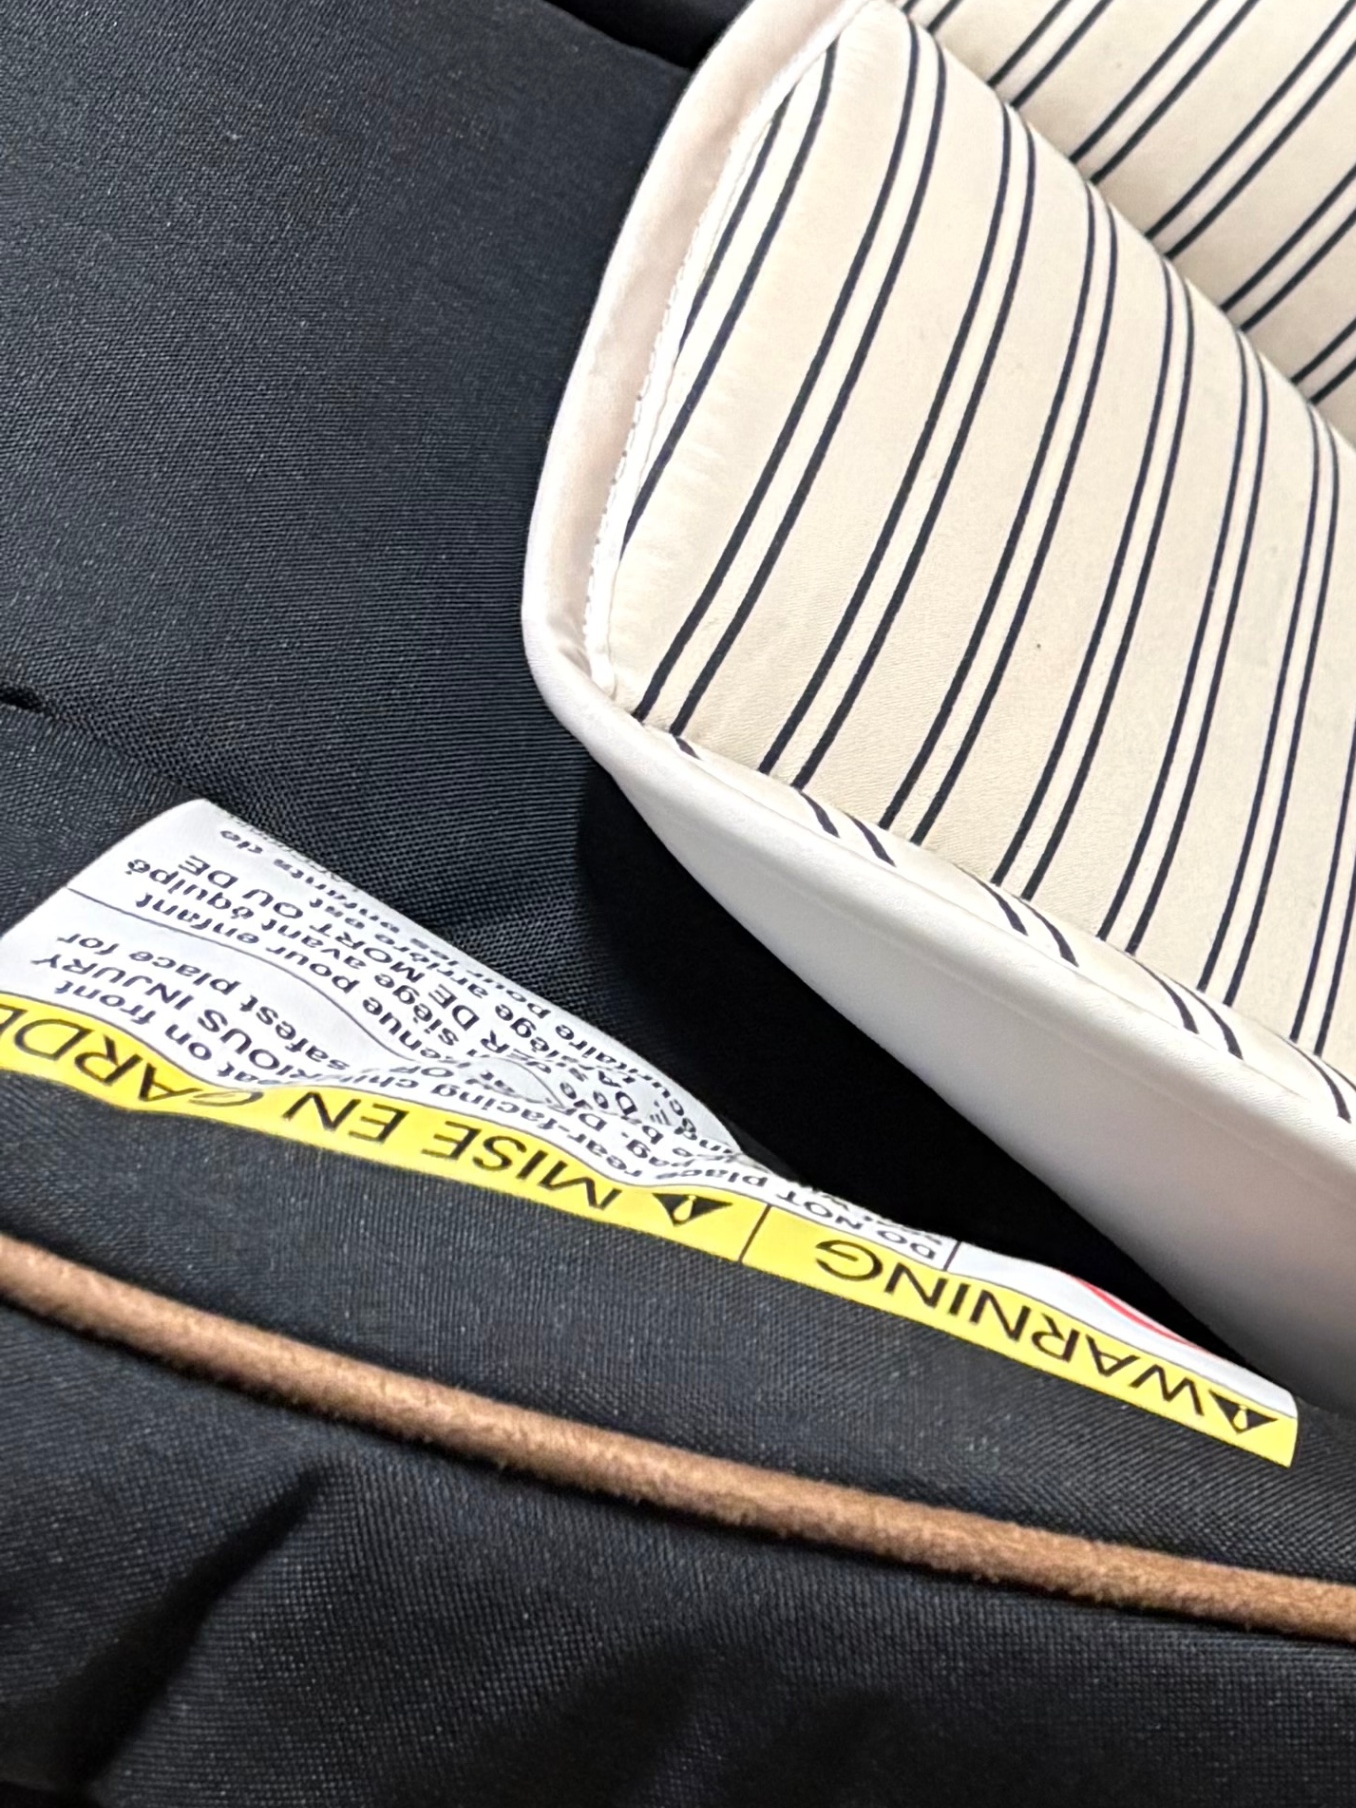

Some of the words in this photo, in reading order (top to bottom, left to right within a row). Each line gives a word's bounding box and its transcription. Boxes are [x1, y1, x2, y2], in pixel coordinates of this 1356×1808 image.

[219, 830, 264, 856] de
[122, 858, 255, 921] équipé
[178, 855, 238, 890] DE
[134, 893, 261, 945] enfant
[242, 888, 303, 920] OU
[308, 897, 366, 931] est
[55, 931, 120, 957] for
[260, 918, 366, 970] avant
[309, 922, 425, 984] MORT
[374, 933, 489, 1000] arrière
[30, 954, 194, 1011] INJURY
[128, 950, 242, 996] place
[264, 945, 361, 994] pour
[54, 980, 157, 1025] front
[373, 972, 459, 1047] siège
[428, 984, 480, 1031] DE
[164, 1024, 213, 1061] on
[239, 995, 351, 1071] safest
[281, 1091, 410, 1145] EN
[430, 1083, 643, 1177] rear-facing
[422, 1121, 622, 1211] MISE
[654, 1168, 769, 1189] place
[776, 1190, 862, 1229] NOT
[878, 1228, 938, 1259] DO
[815, 1239, 1205, 1417] WARNING
